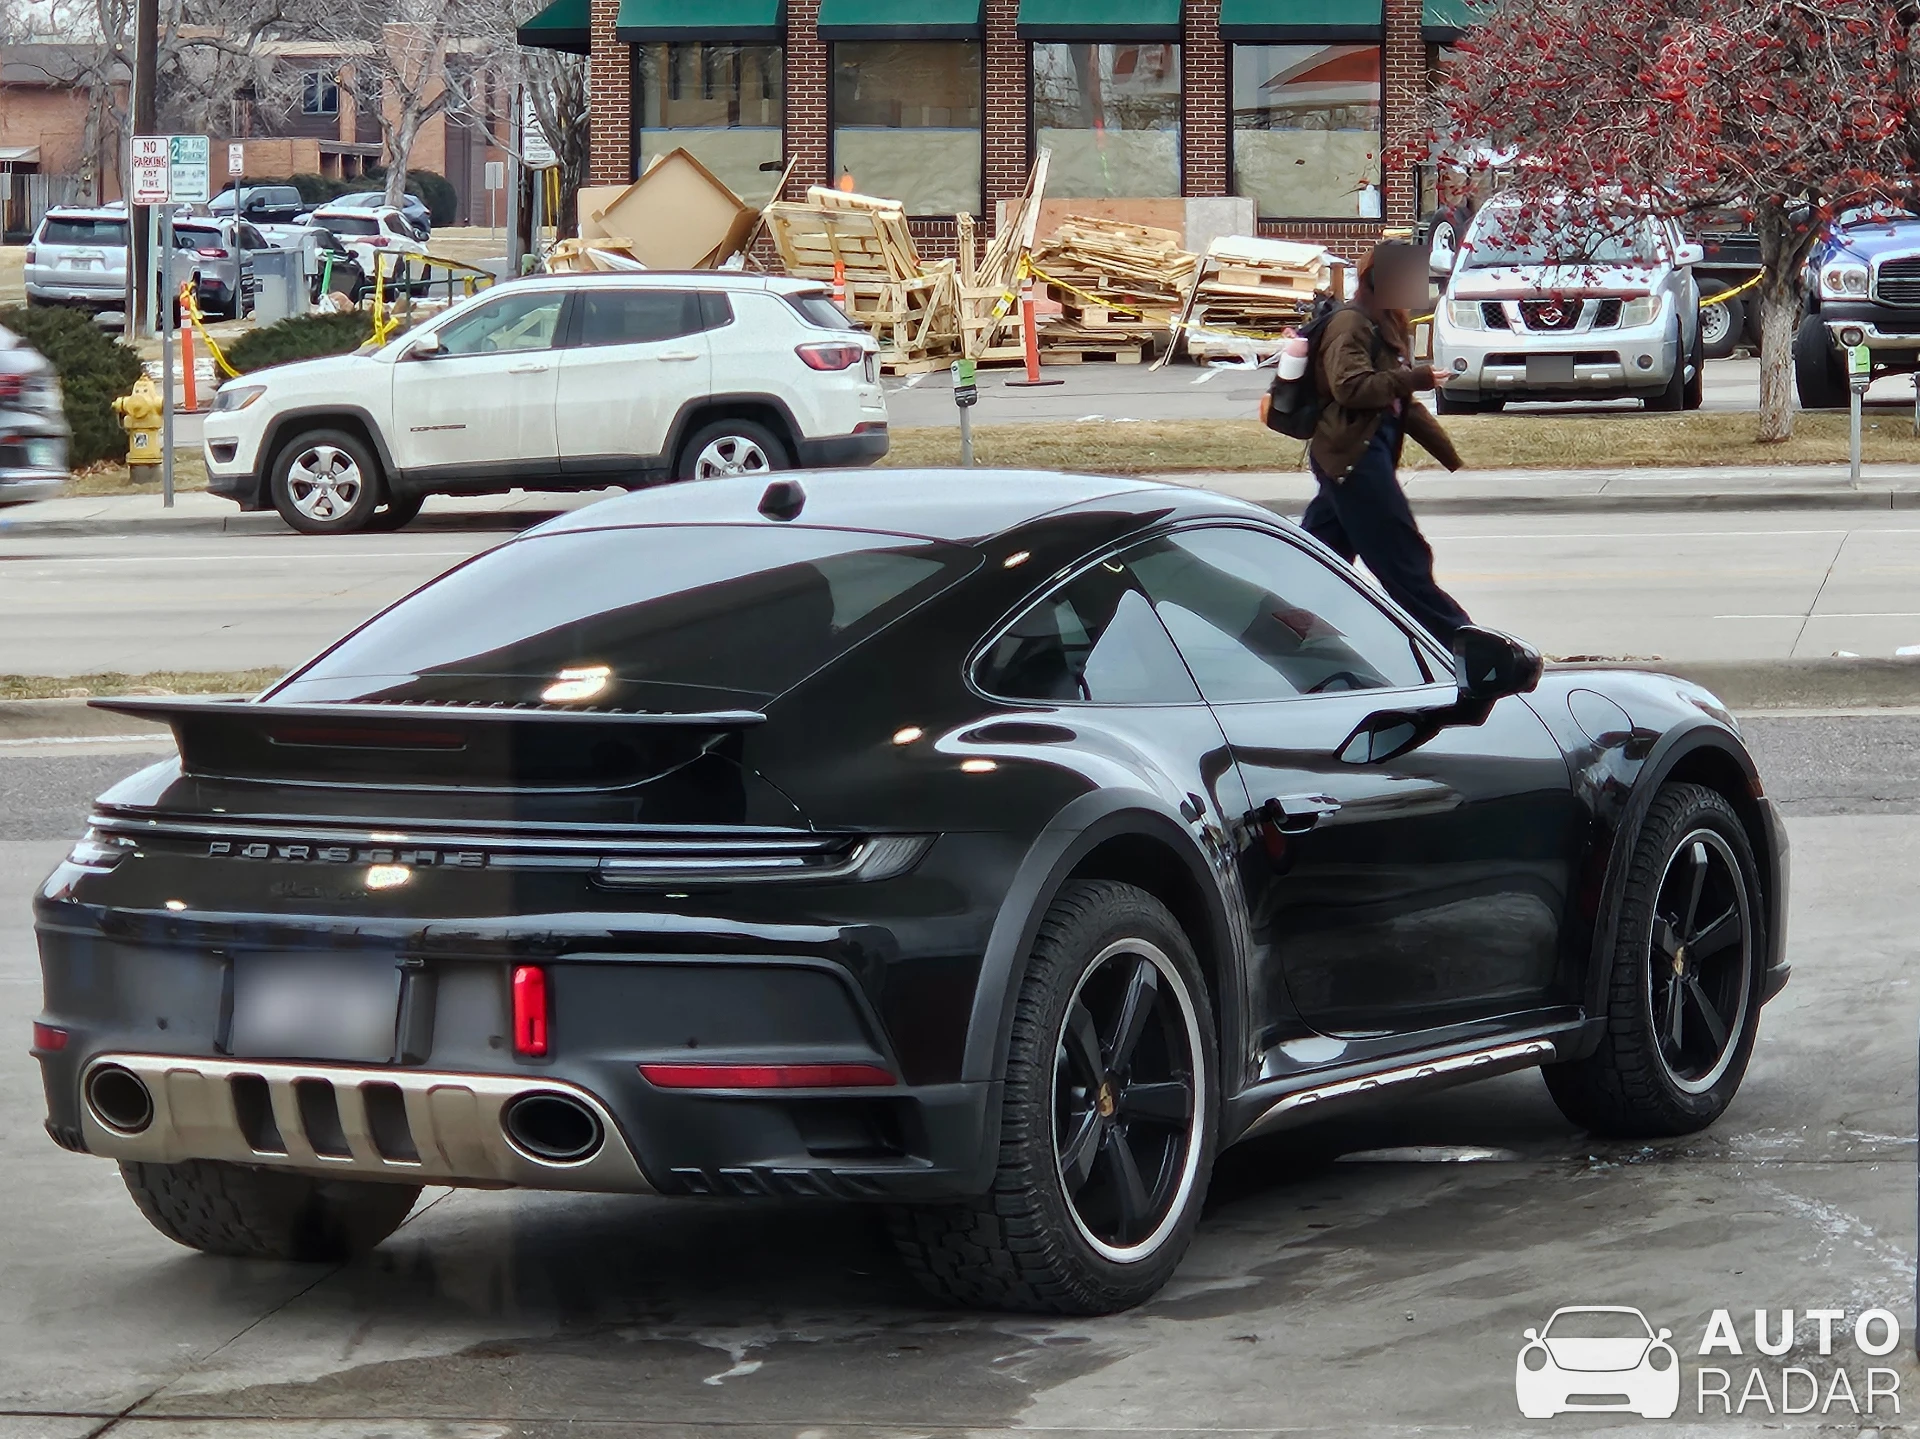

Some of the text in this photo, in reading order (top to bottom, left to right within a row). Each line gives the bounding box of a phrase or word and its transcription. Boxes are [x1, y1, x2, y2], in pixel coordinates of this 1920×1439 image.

[143, 141, 157, 153] NO
[171, 142, 179, 160] 2
[134, 156, 166, 167] PARKING
[142, 180, 159, 188] TIME
[210, 841, 486, 868] PORSCHE
